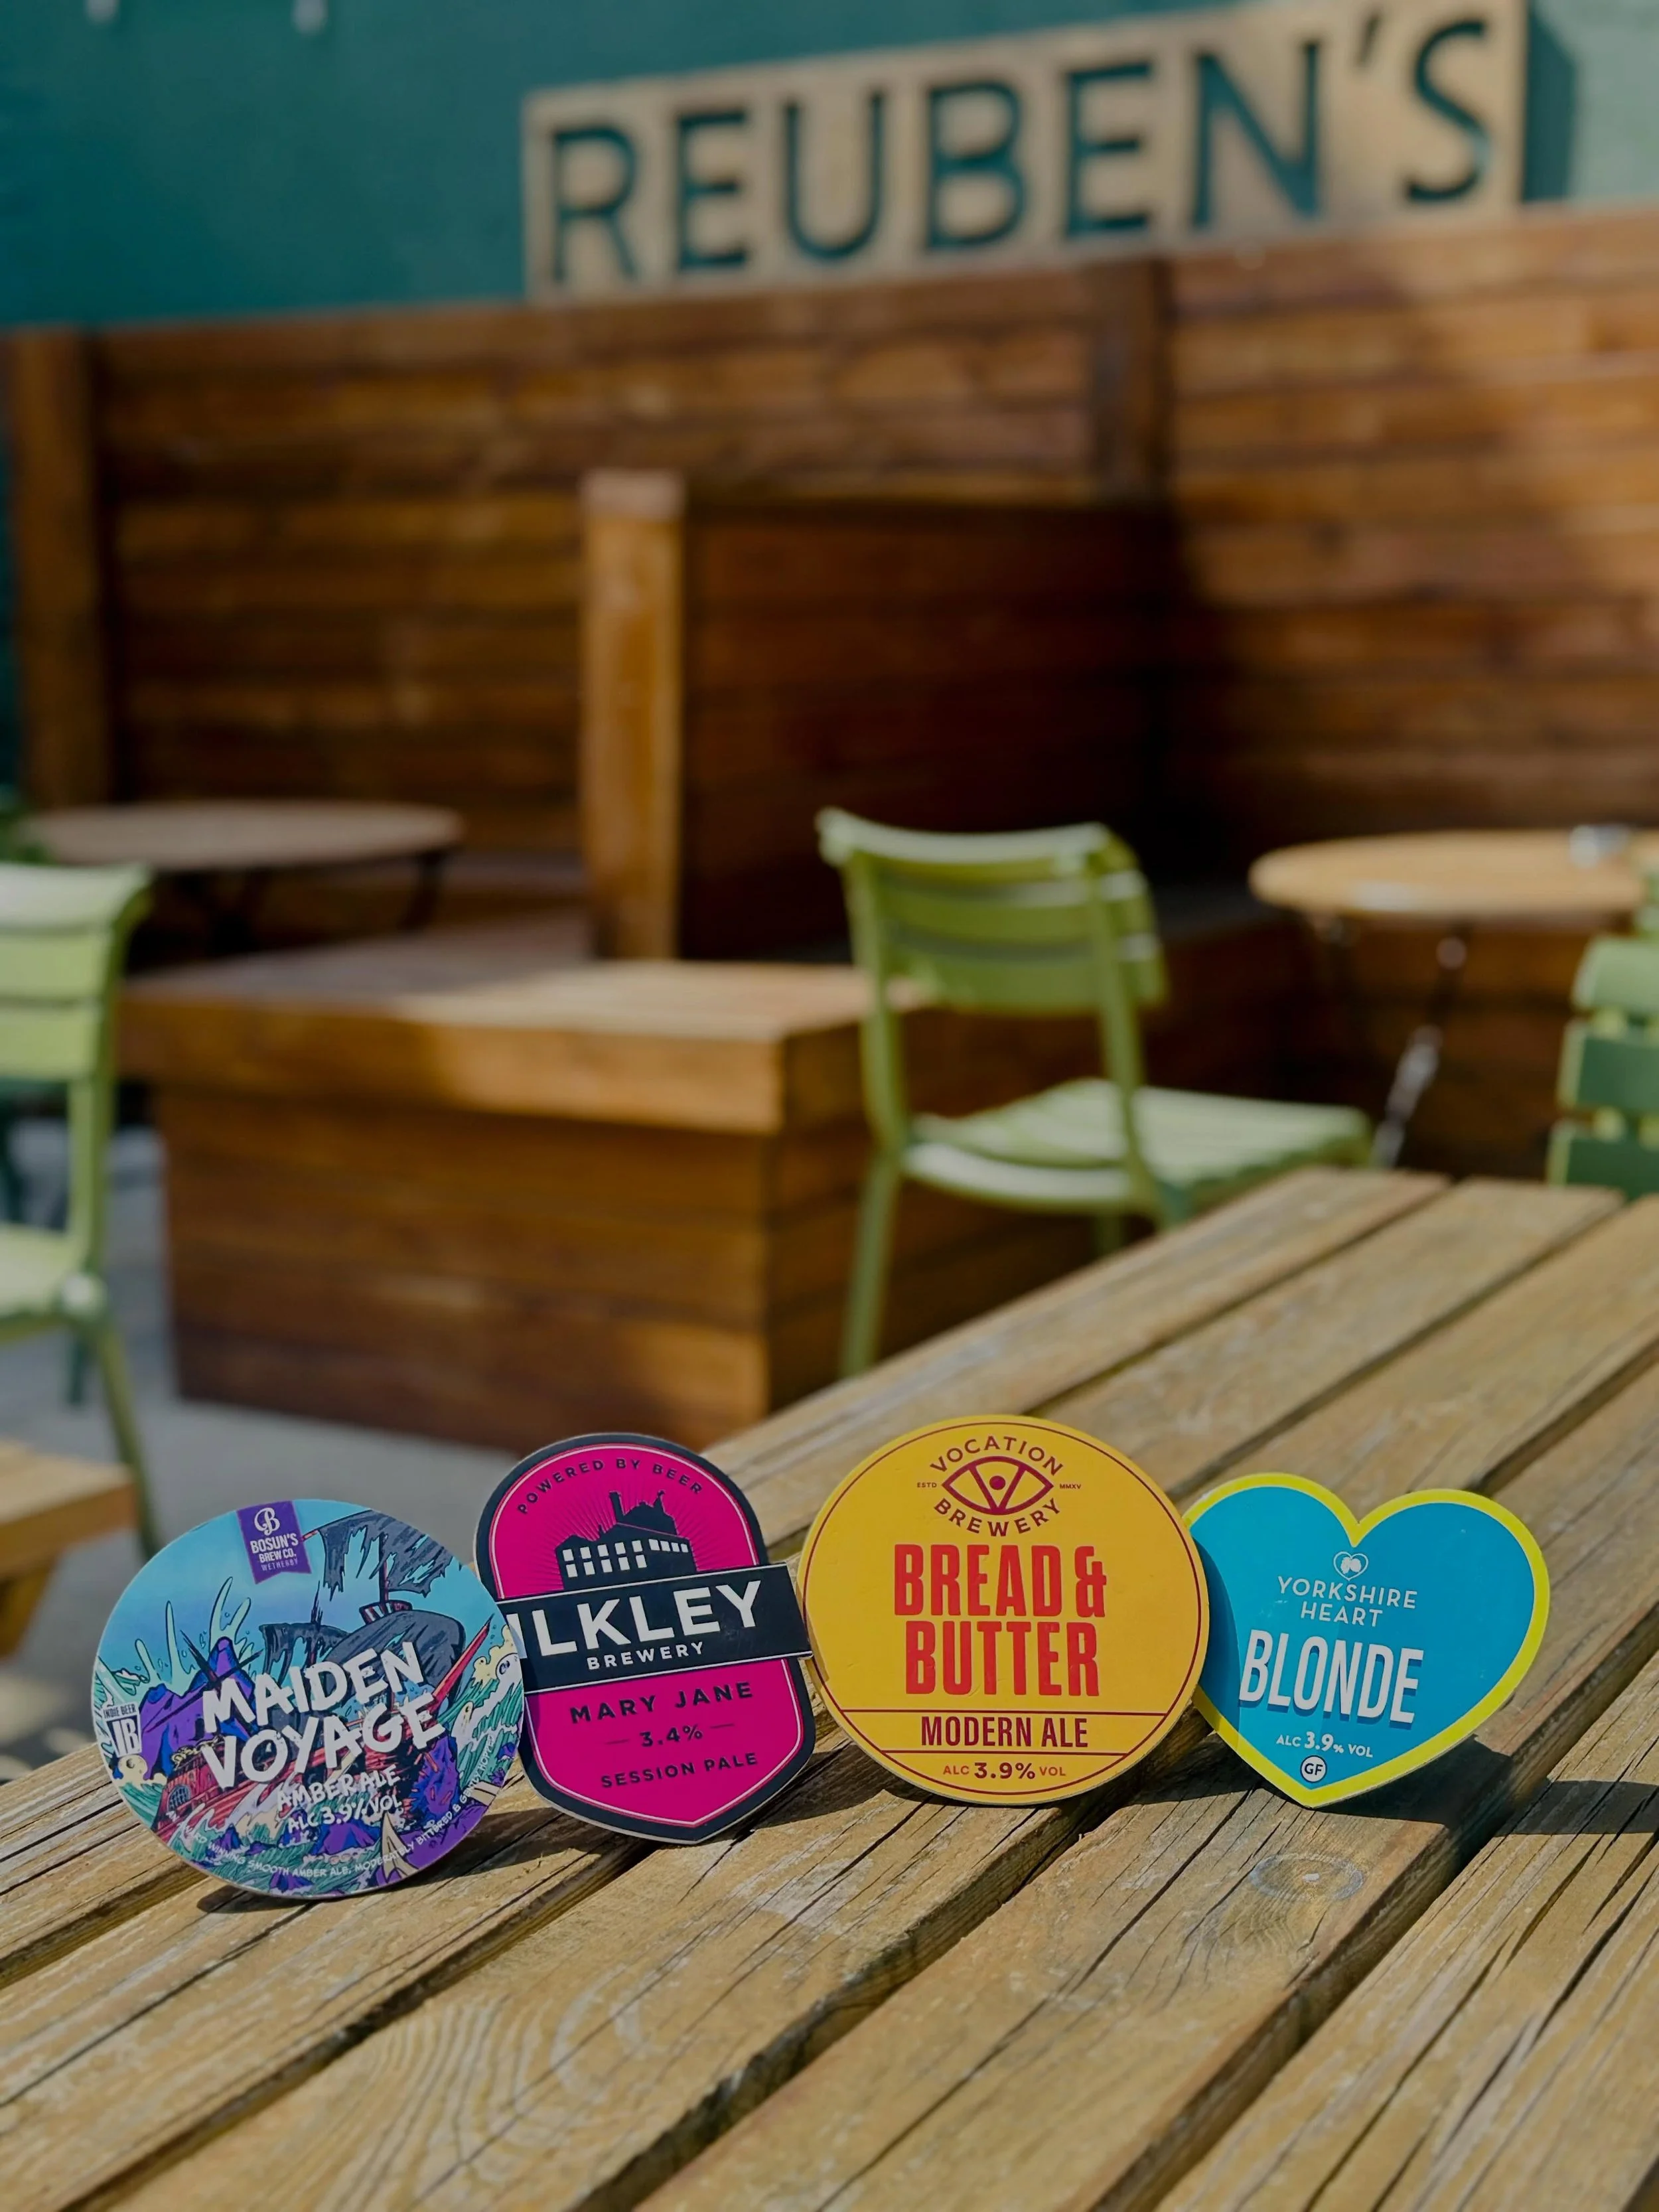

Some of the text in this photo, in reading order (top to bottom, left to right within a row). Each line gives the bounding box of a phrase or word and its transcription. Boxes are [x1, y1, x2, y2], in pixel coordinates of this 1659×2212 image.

[549, 9, 1491, 285] REUBEN'S
[930, 1436, 1063, 1476] VOCATION
[518, 1458, 703, 1514] POWERED BY BEER
[934, 1498, 1060, 1537] BREWERY
[250, 1533, 299, 1554] BOSUN'S
[259, 1548, 297, 1563] BREW CO.
[894, 1544, 1107, 1617] BREAD &
[1277, 1576, 1417, 1609] YORKSHIRE
[506, 1580, 760, 1659] ILKLEY
[1300, 1601, 1383, 1627] HEART
[587, 1641, 705, 1670] BREWERY
[906, 1621, 1100, 1696] BUTTER
[202, 1641, 424, 1733] MAIDEN
[1239, 1629, 1424, 1724] BLONDE
[103, 1704, 137, 1718] INDIE BEER
[570, 1682, 753, 1724] MARY JANE
[111, 1718, 140, 1756] IB
[200, 1692, 446, 1791] VOYAGE
[640, 1725, 703, 1747] 3.4%
[921, 1716, 1088, 1747] MODERN ALE
[1276, 1731, 1373, 1758] ALC 3.9% VOL
[277, 1764, 401, 1811] AMBER ALE
[601, 1753, 758, 1787] SESSION PALE
[943, 1762, 1066, 1779] ALC 3.9% VOL
[1304, 1763, 1323, 1775] GF
[248, 1860, 289, 1876] SMOOTH
[292, 1868, 327, 1878] AMBER
[354, 1841, 414, 1872] MODERATELY
[415, 1811, 453, 1845] BITTERED
[460, 1771, 482, 1804] GENTLY
[288, 1794, 402, 1833] ALC 3.9% VOL
